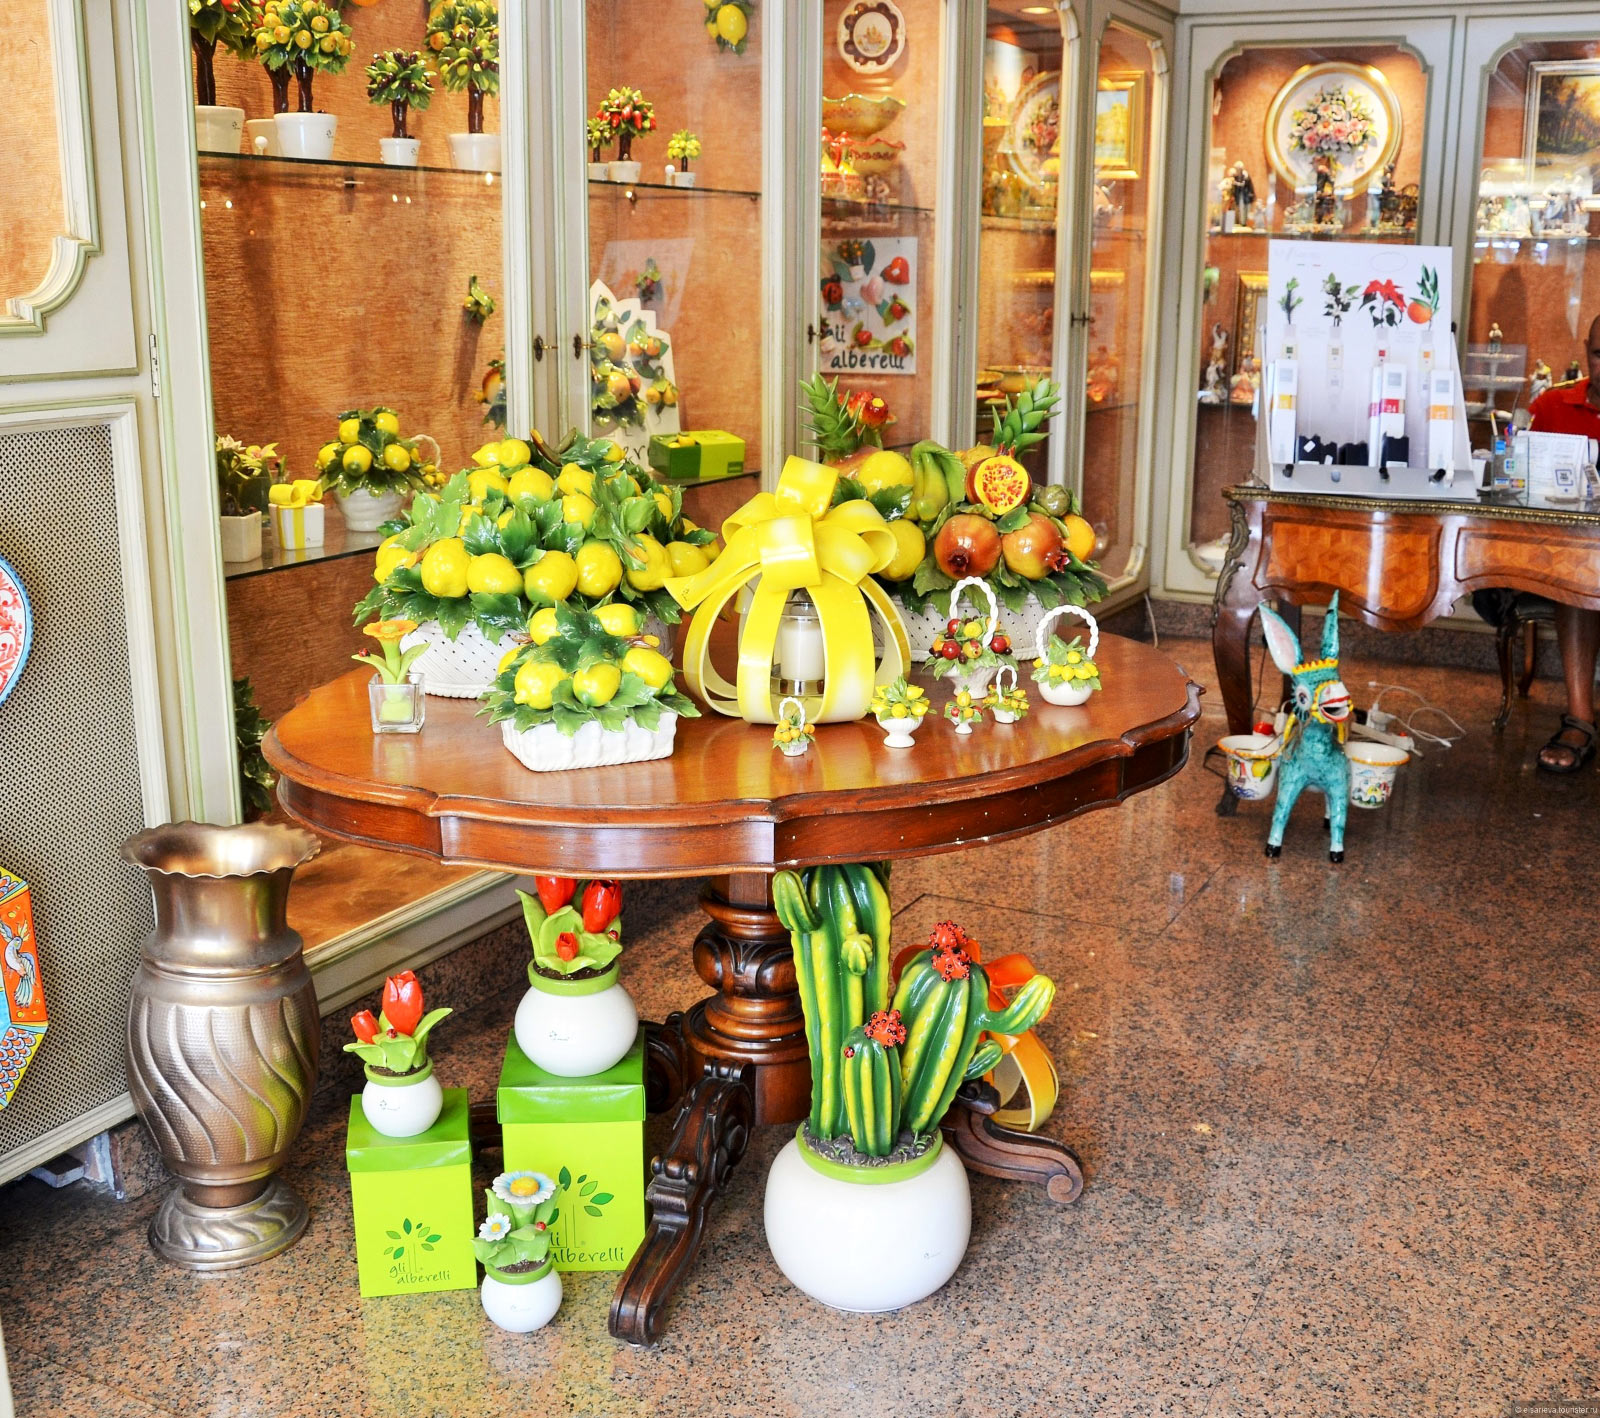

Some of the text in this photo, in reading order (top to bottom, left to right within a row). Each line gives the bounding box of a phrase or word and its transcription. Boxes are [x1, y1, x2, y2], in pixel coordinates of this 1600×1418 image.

[550, 1231, 560, 1247] li
[389, 1262, 406, 1279] gli
[396, 1269, 451, 1285] alberelli
